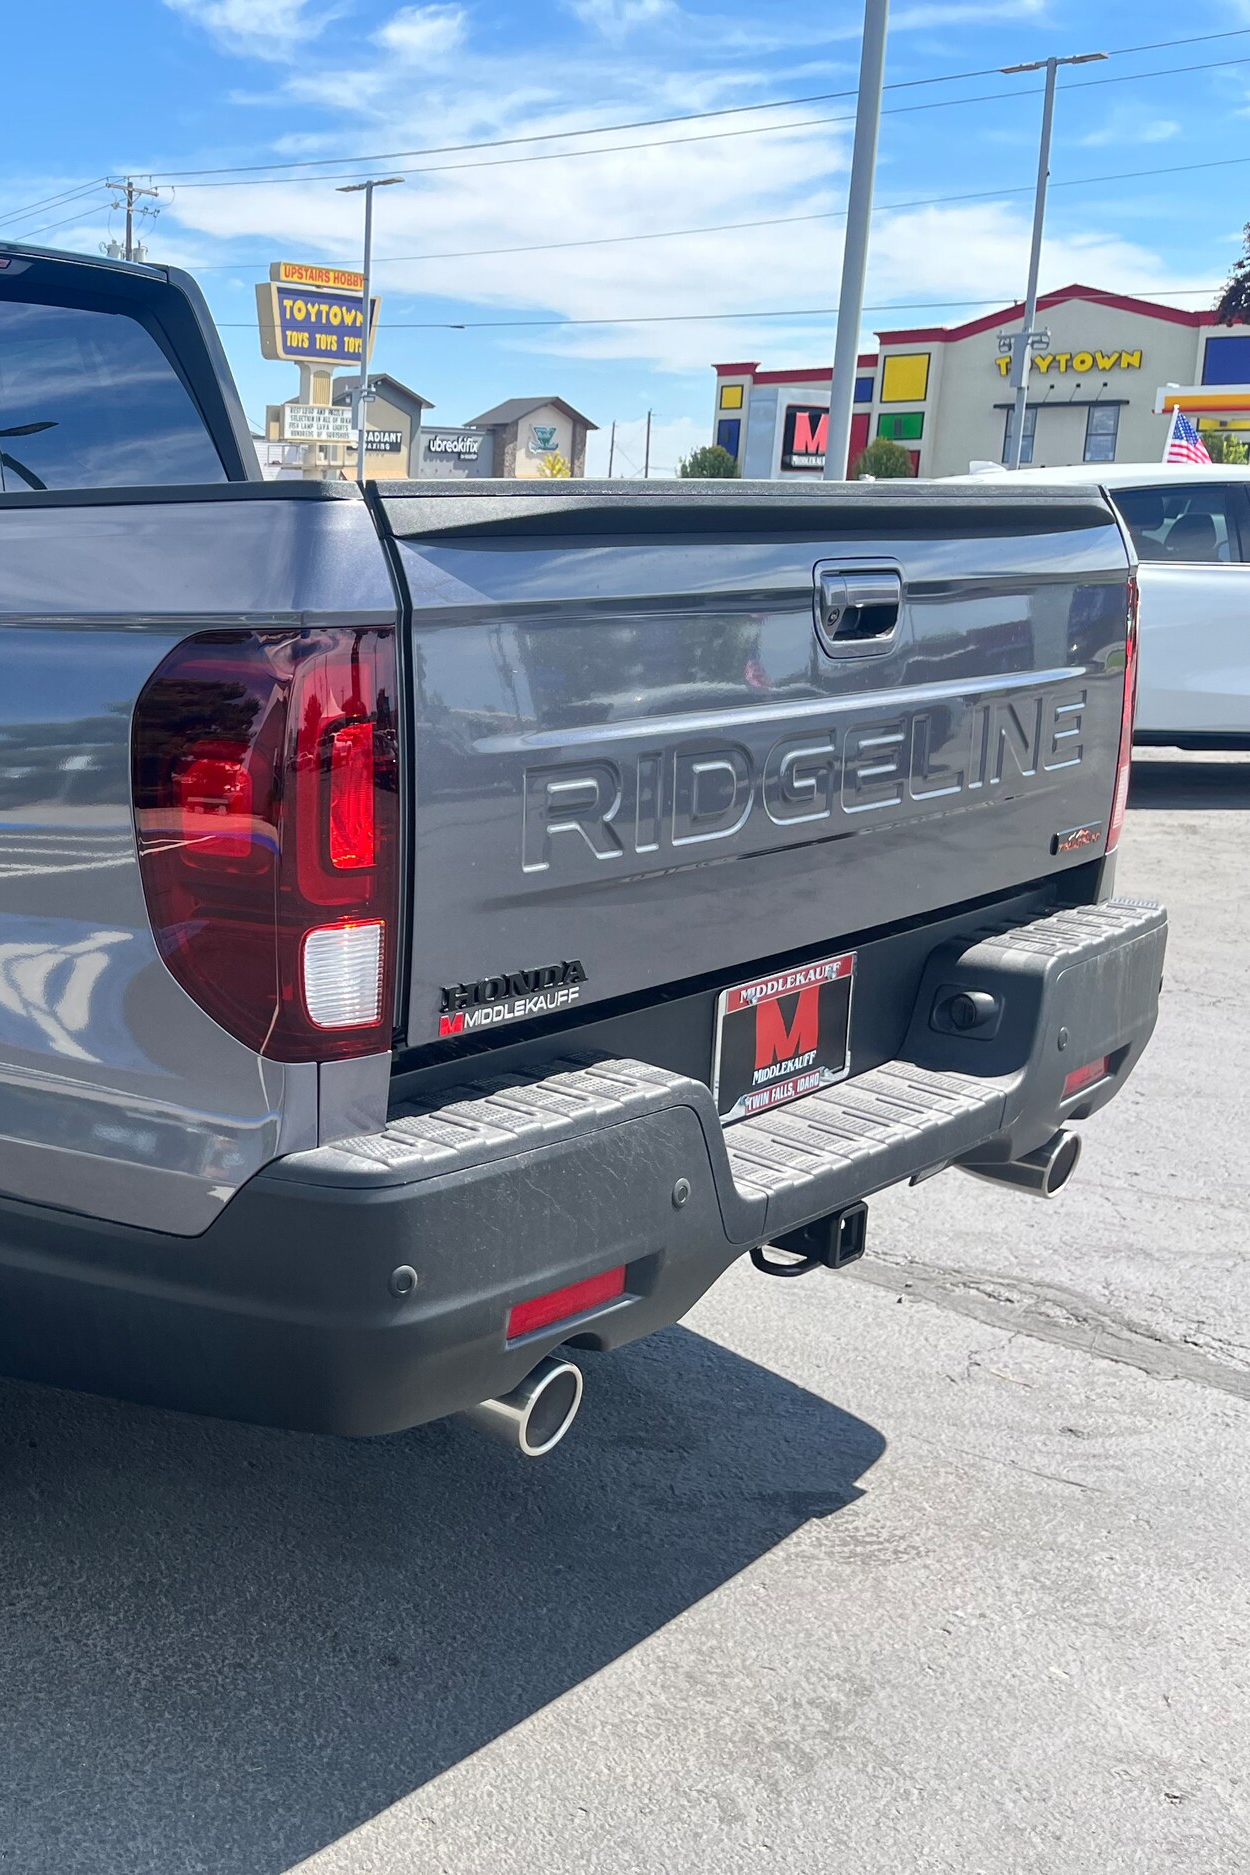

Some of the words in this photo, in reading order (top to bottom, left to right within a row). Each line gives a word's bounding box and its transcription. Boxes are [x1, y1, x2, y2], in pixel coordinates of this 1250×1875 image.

[284, 265, 330, 283] UPSTAIRS
[333, 272, 363, 288] HOBBY
[286, 330, 309, 348] TOYS
[315, 333, 337, 351] TOYS
[995, 350, 1143, 376] TYTOWN
[430, 436, 478, 453] ubreakifix
[792, 411, 829, 454] M
[522, 688, 1087, 873] RIDGELINE
[439, 959, 589, 1013] HONDA
[740, 961, 842, 1004] MIDDLEKAUFF
[463, 987, 580, 1029] MIDDLEKAUFF
[755, 985, 821, 1070] M
[752, 1050, 817, 1086] MIDDLEKAUFF
[747, 1091, 769, 1111] TWIN
[771, 1081, 795, 1103] FALLS,
[797, 1072, 820, 1092] IDAHO
